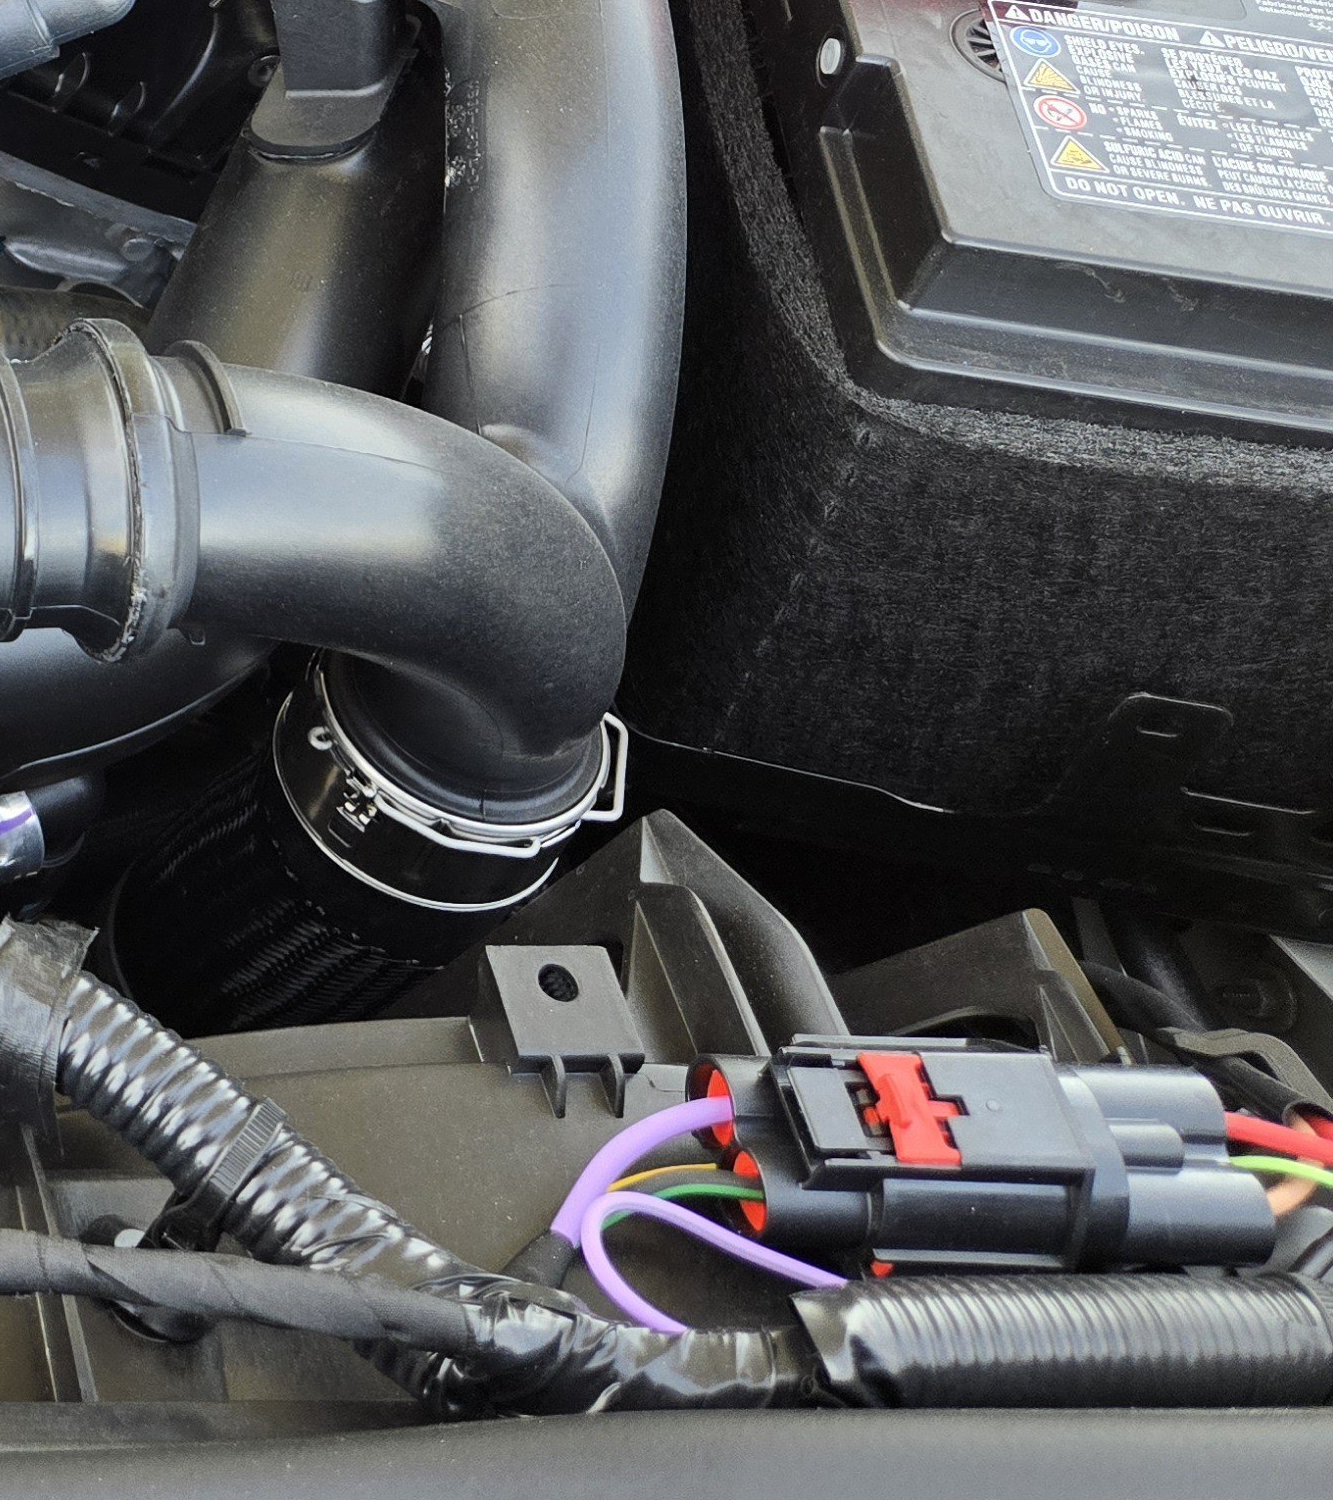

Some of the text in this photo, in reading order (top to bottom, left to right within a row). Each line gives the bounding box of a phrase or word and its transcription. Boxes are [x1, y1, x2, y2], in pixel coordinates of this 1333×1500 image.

[1028, 7, 1180, 42] DANGER/POISON
[1064, 34, 1108, 50] SHIELD
[1067, 43, 1135, 64] EXPLOSIVE
[1161, 47, 1178, 58] SE
[1071, 54, 1112, 70] GASES
[1165, 57, 1188, 70] LES
[1228, 65, 1252, 78] LES
[1253, 69, 1280, 82] GAZ
[1076, 66, 1112, 79] CAUSE
[1169, 68, 1287, 93] EXPLOSIFS PEUVENT
[1080, 75, 1142, 93] BLINDNESS
[1084, 86, 1099, 97] OR
[1173, 78, 1243, 96] CAUSER DES
[1178, 89, 1277, 110] BLESSURES ET LA
[1088, 102, 1159, 121] NO SPARKS
[1119, 116, 1164, 132] FLAMES
[1176, 112, 1315, 143] ÉVITEZ LES ÉTINCELLES
[1123, 126, 1174, 142] SMOKING
[1233, 132, 1309, 151] LES FLAMMES
[1103, 141, 1207, 165] SULFURIC ACID CAN
[1238, 142, 1294, 159] DE FUMER
[1109, 152, 1204, 176] CAUSE BLINDNESS
[1113, 164, 1130, 176] OR
[1129, 166, 1170, 182] SEVERE
[1211, 156, 1257, 172] L'ACIDE
[1216, 169, 1242, 181] PEUT
[1242, 172, 1282, 187] CAUSER
[1280, 177, 1294, 189] LA
[1221, 181, 1242, 193] DES
[1065, 176, 1186, 206] DO NOT OPEN.
[1192, 194, 1331, 227] NE PAS OUVRIR.
